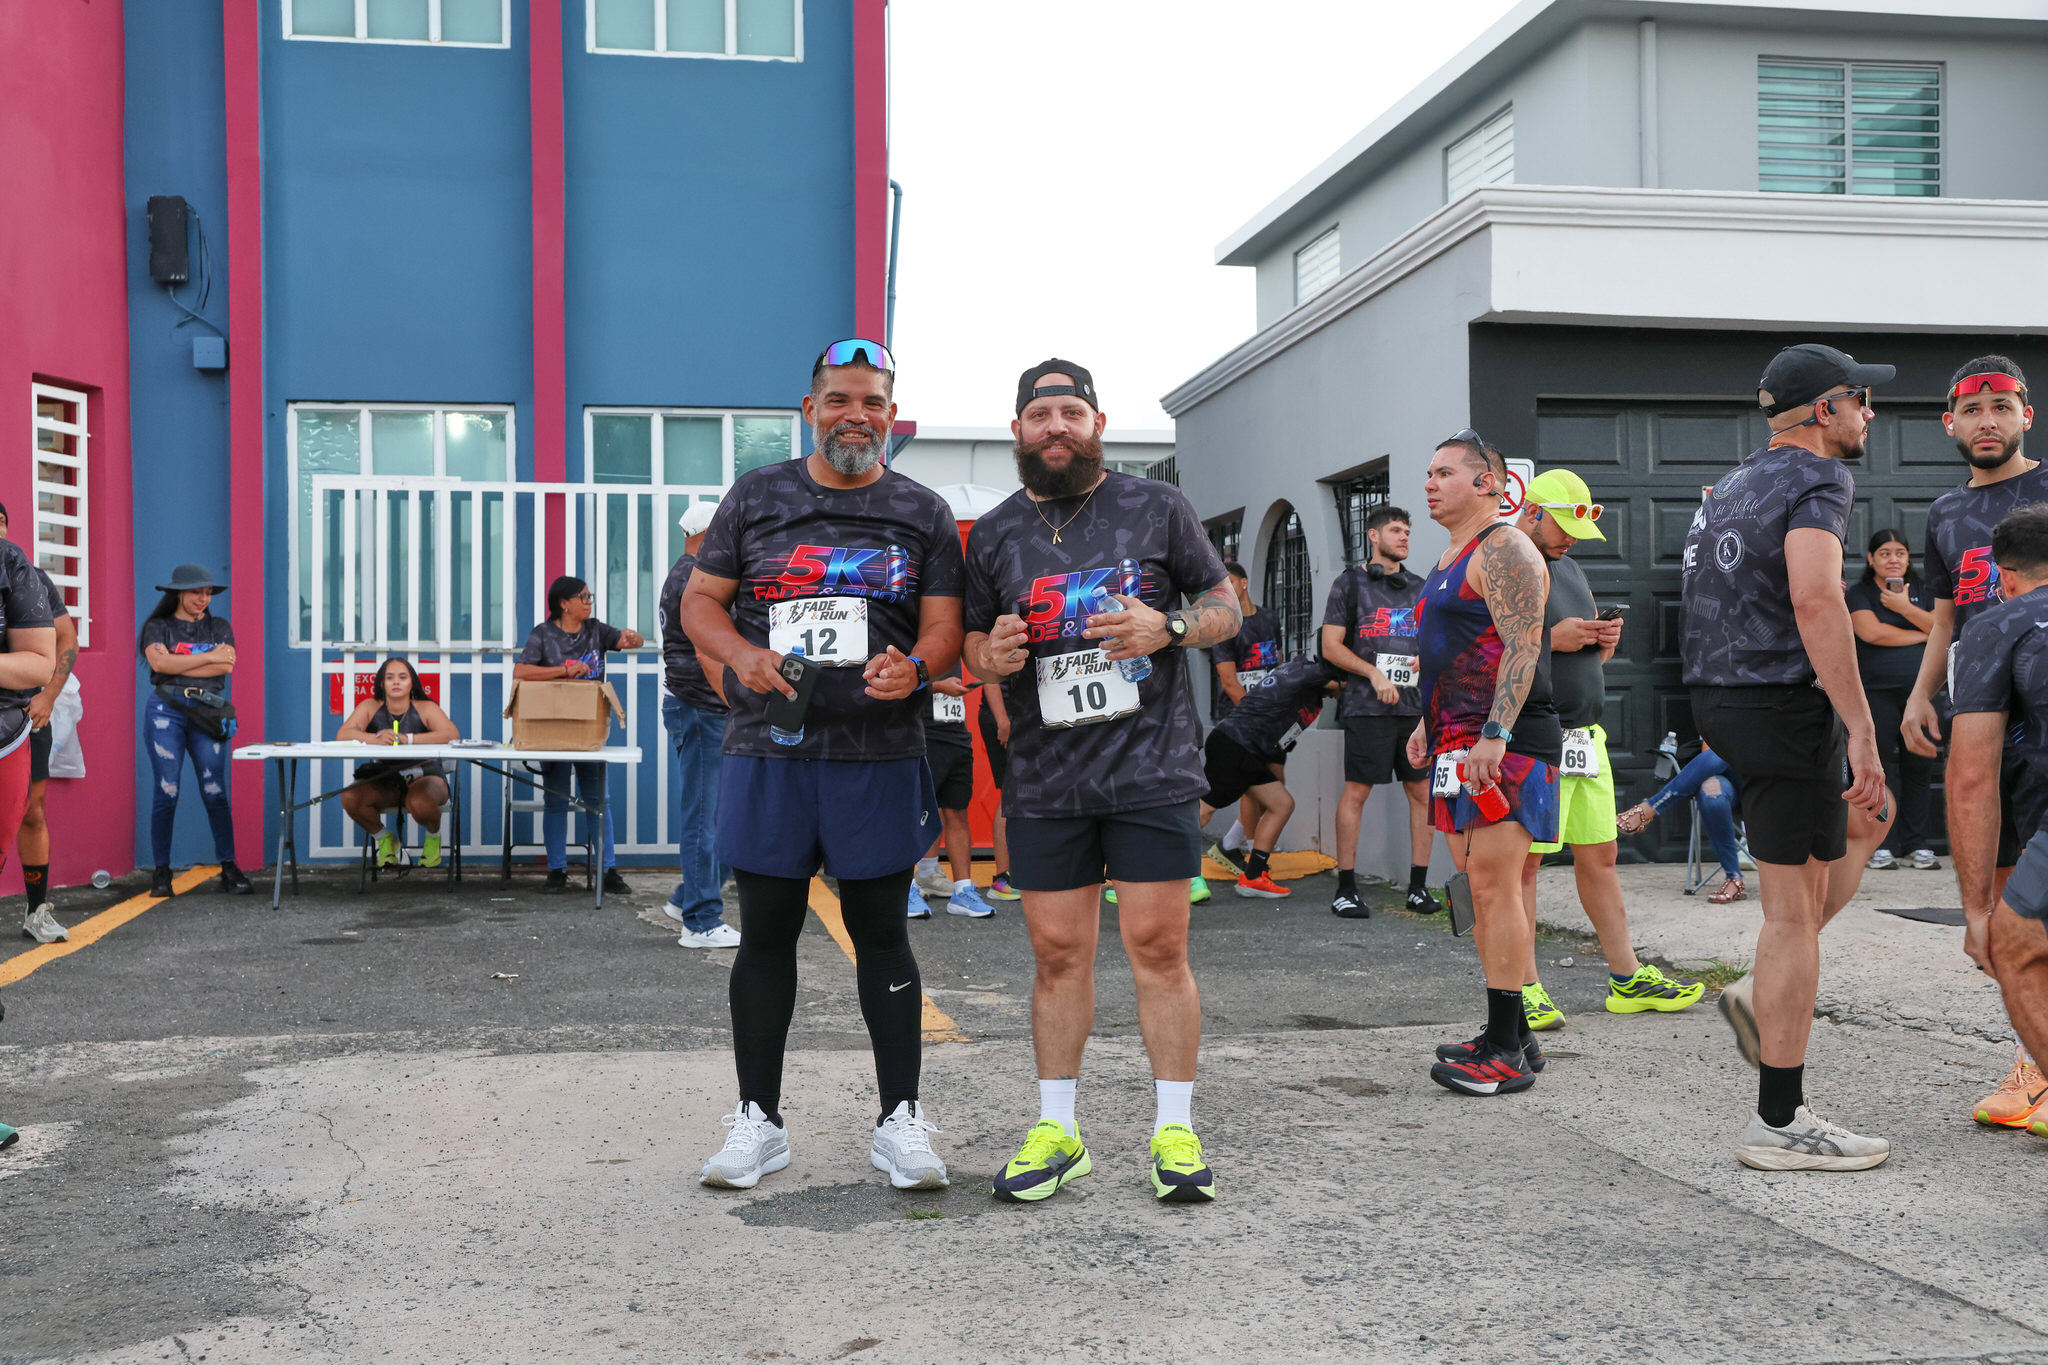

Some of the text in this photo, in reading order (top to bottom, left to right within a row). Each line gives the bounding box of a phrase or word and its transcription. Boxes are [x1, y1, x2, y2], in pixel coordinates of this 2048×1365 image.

[776, 545, 884, 588] 5K
[754, 586, 819, 600] FADE
[1026, 567, 1117, 625] 5K
[1954, 585, 1988, 606] DE
[803, 600, 837, 612] FADE
[811, 611, 849, 620] & RUN
[1374, 608, 1412, 628] 5K
[1022, 622, 1060, 643] DE
[1061, 620, 1078, 638] &
[1360, 628, 1389, 637] FADE
[800, 628, 837, 656] 12
[1250, 641, 1272, 660] 5K
[1065, 651, 1100, 668] FADE
[1075, 661, 1113, 675] & RUN
[1386, 668, 1410, 683] 199
[1067, 681, 1107, 713] 10
[943, 703, 962, 717] 142
[1569, 730, 1584, 738] FADE
[1565, 749, 1586, 769] 69
[1435, 766, 1449, 788] 65
